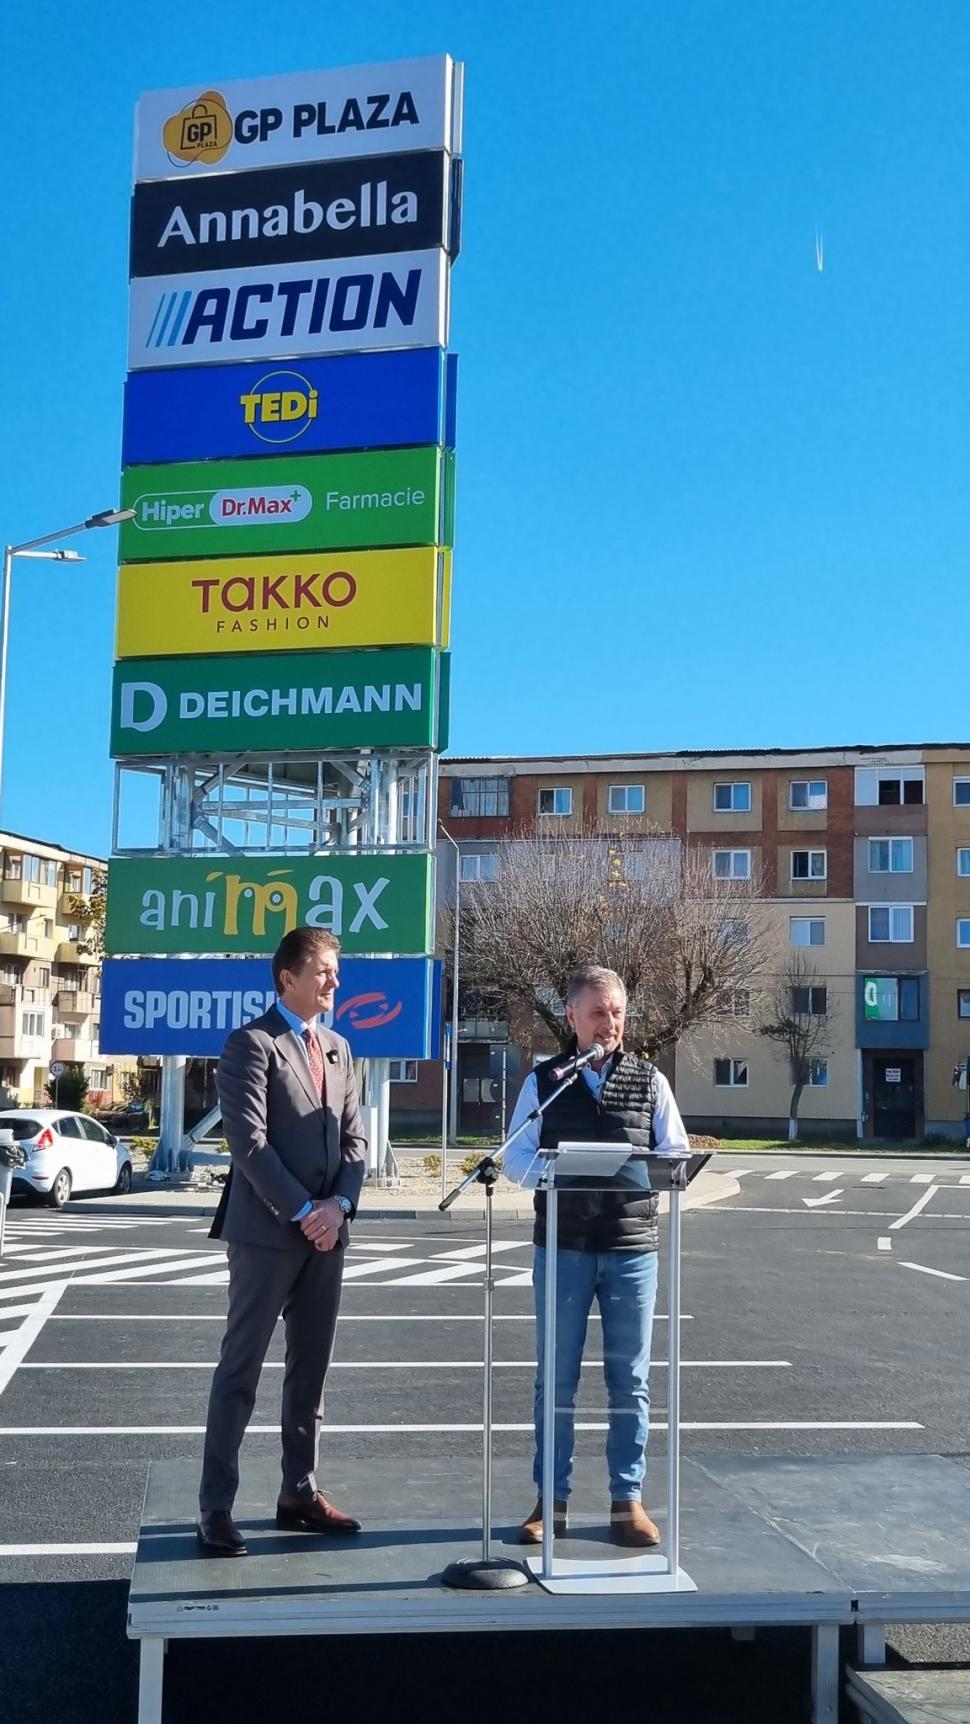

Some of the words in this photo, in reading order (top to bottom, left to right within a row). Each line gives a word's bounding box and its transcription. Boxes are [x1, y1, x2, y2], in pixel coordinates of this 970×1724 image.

[187, 121, 212, 143] GP
[233, 107, 283, 144] GP
[293, 91, 420, 138] PLAZA
[196, 141, 218, 149] PLAZA
[157, 180, 418, 248] Annabella
[182, 269, 422, 345] ACTION
[240, 389, 319, 425] TEDi
[142, 499, 205, 525] Hiper
[325, 487, 425, 511] Farmacie
[216, 615, 330, 633] FASHION
[179, 683, 422, 719] DEICHMANN
[139, 870, 390, 936] animax
